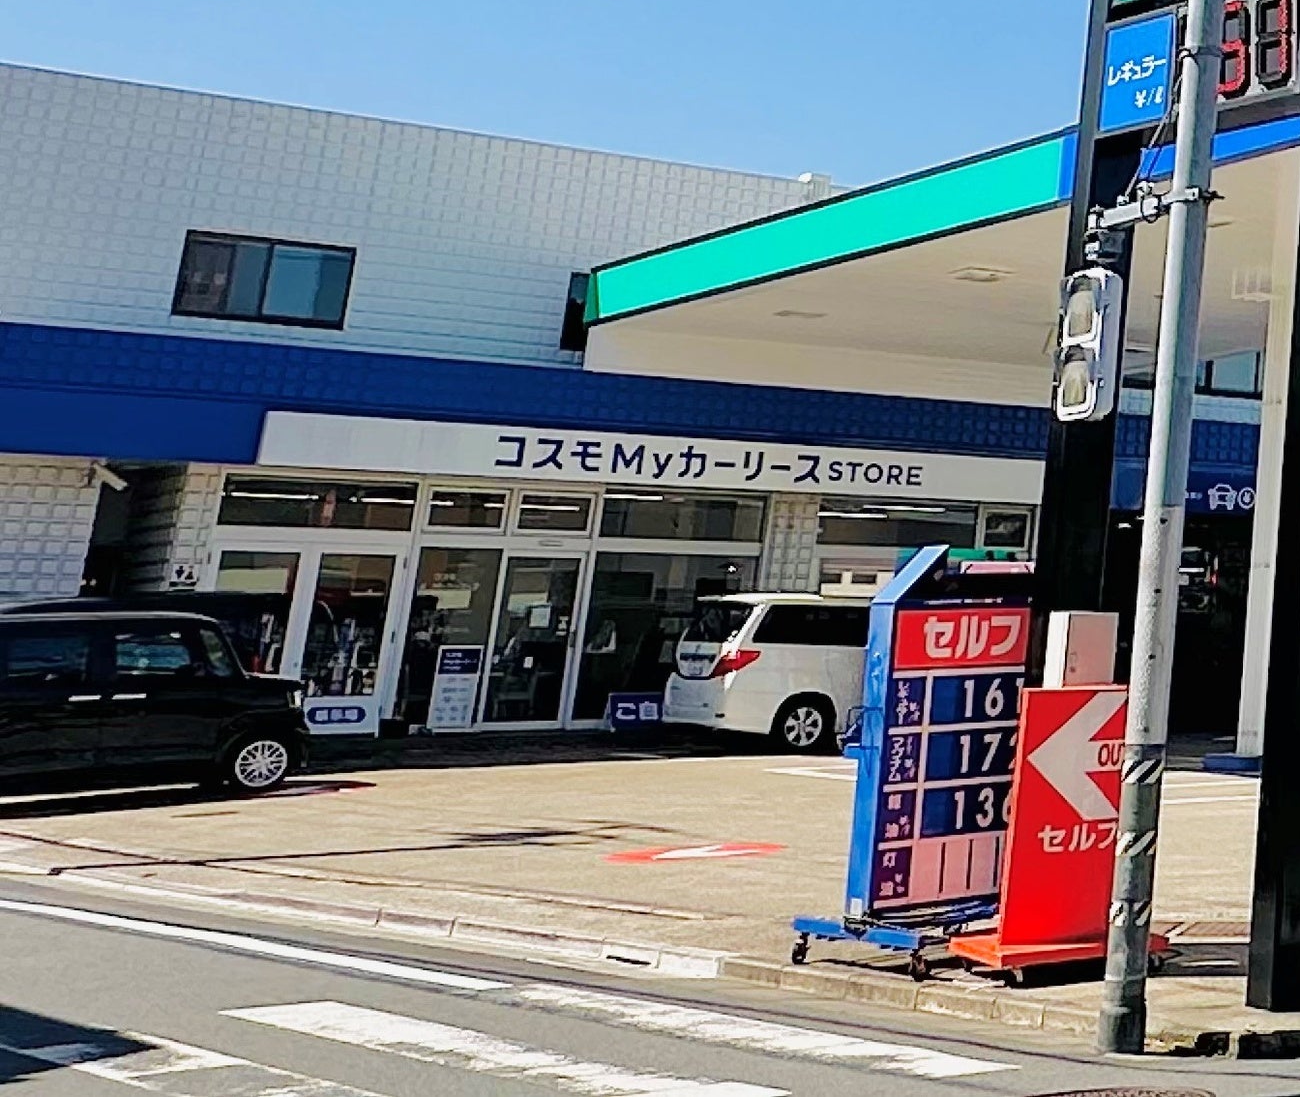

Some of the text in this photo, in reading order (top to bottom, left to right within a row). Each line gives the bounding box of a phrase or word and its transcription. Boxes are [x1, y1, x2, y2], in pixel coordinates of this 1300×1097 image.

[1107, 54, 1167, 87] レギュラー
[494, 435, 924, 487] コスモMyカーリース STORE
[923, 614, 1022, 661] セルフ
[1097, 742, 1124, 768] OU
[1037, 822, 1120, 854] セルフ
